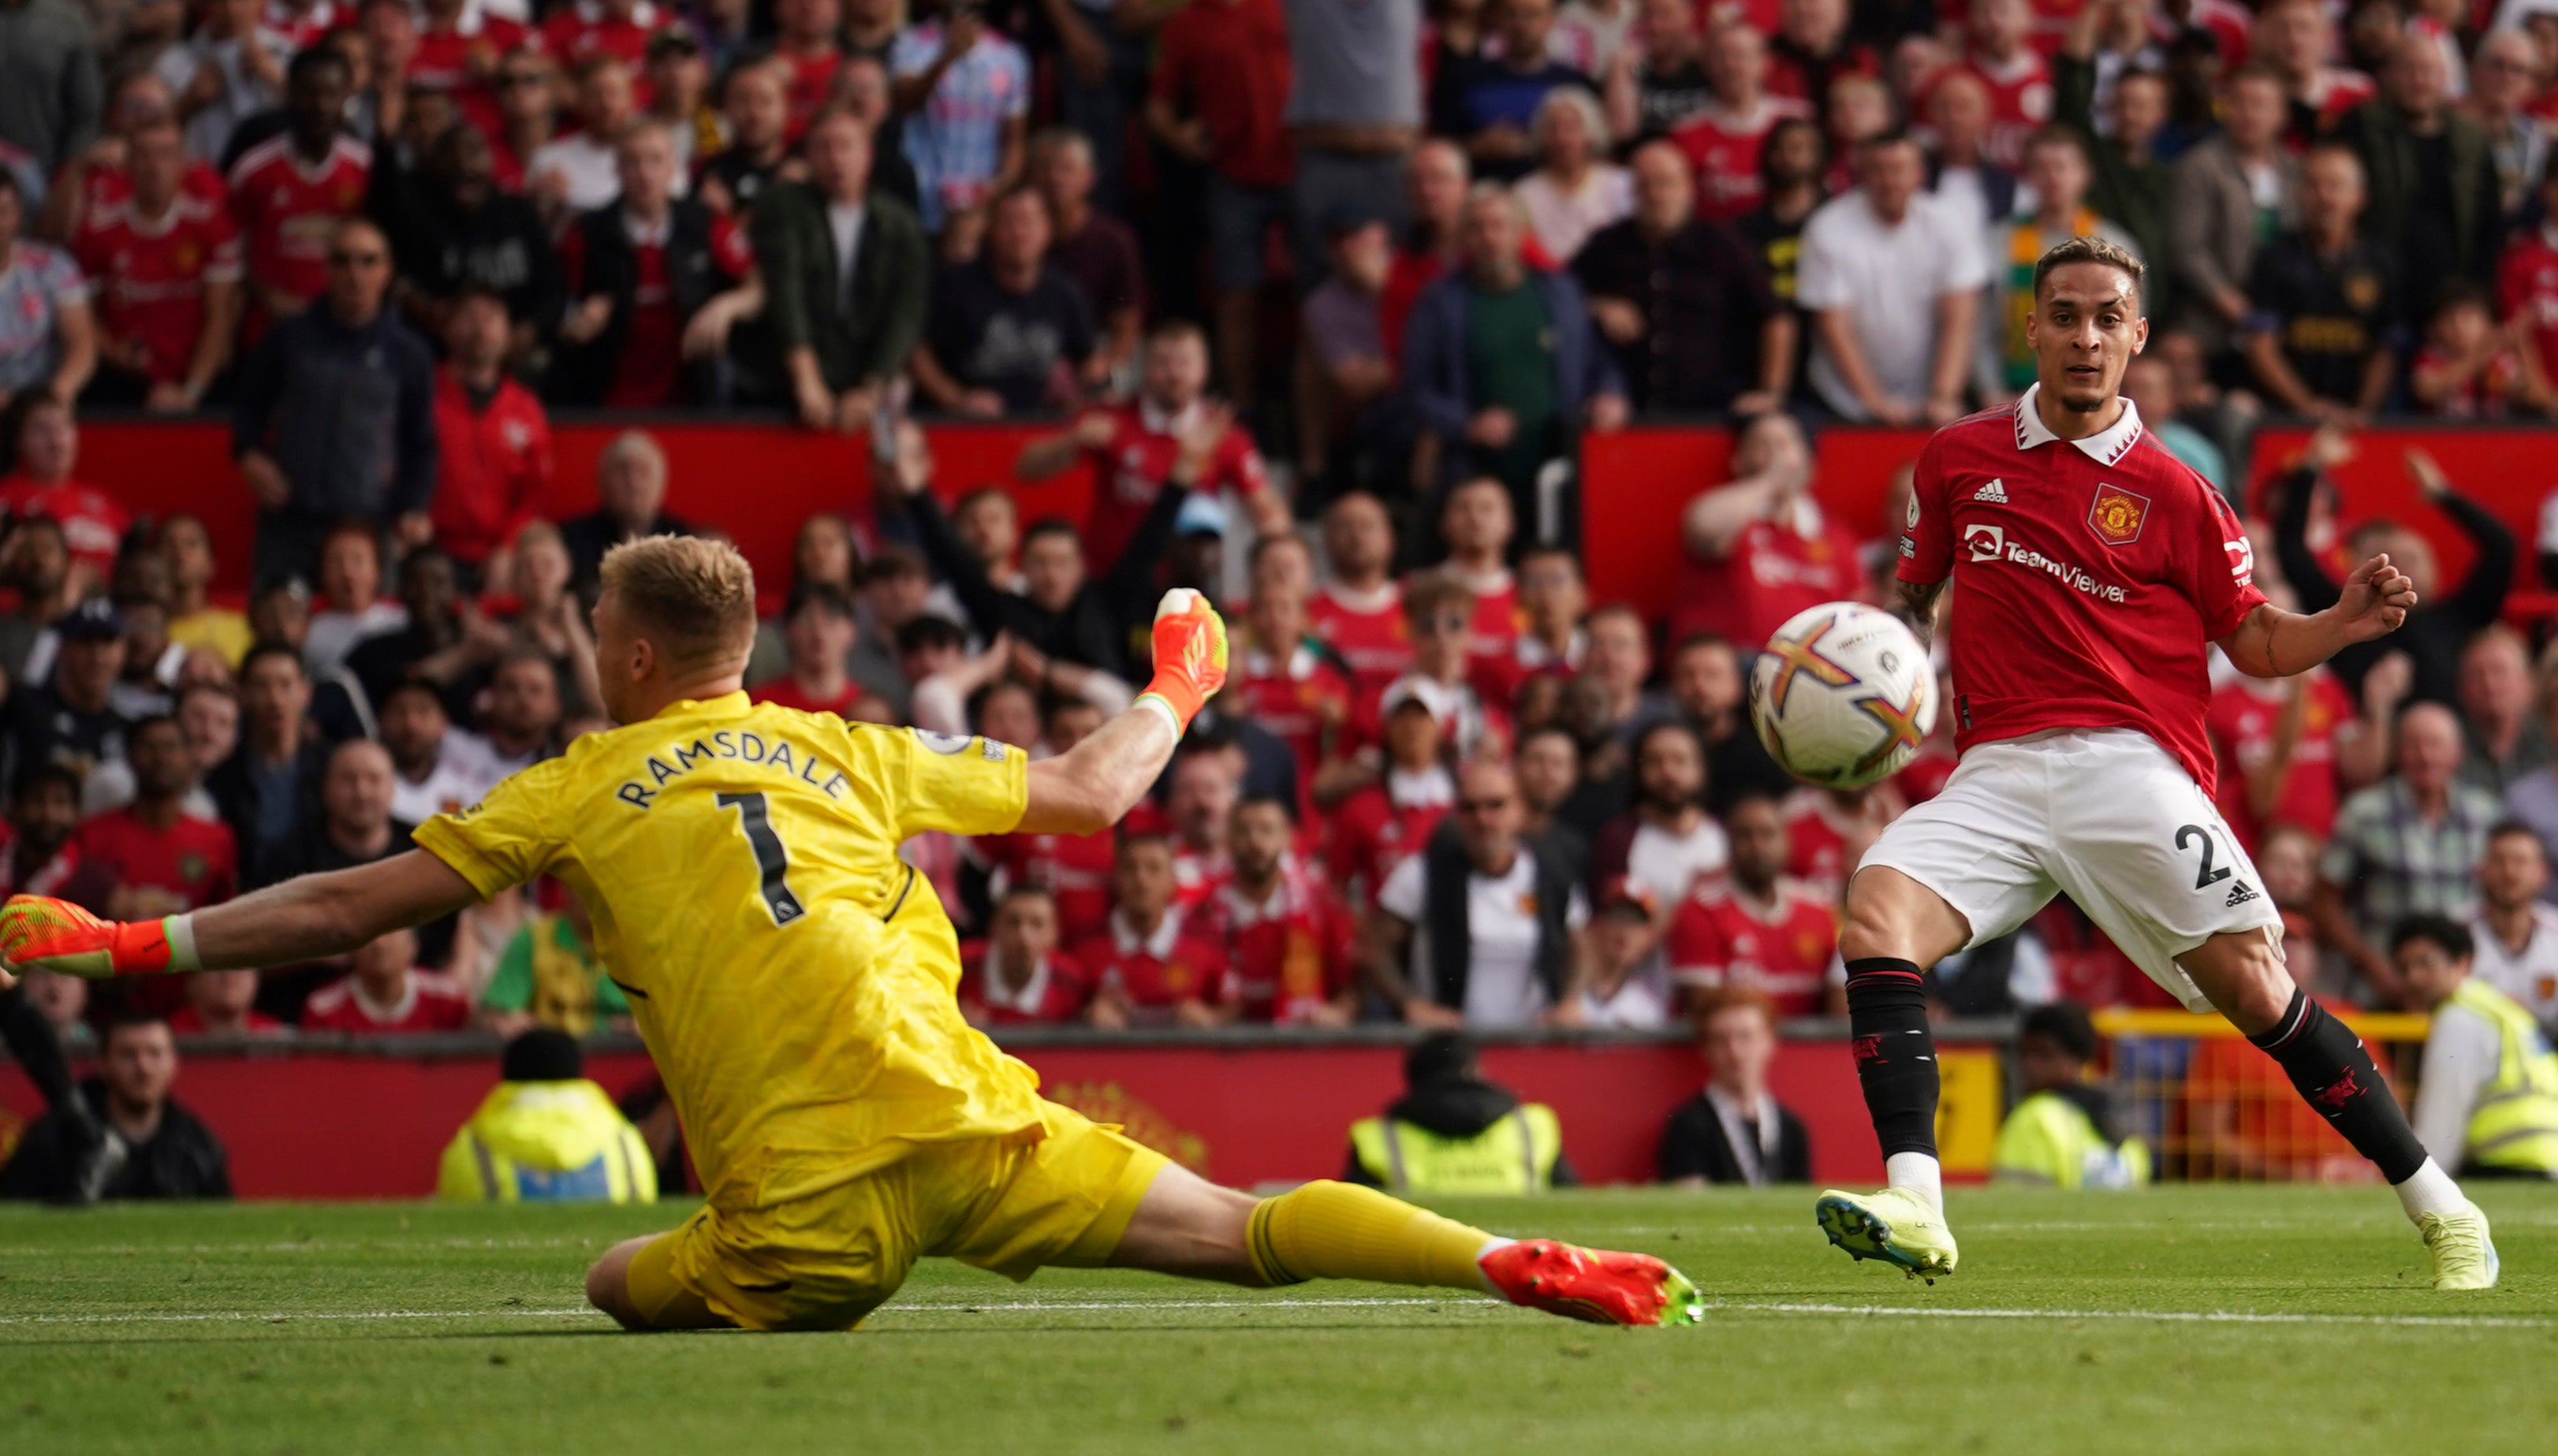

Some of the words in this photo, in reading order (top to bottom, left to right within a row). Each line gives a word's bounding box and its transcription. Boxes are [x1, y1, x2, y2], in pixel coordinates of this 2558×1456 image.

[1973, 492, 2009, 504] adidas
[2004, 541, 2131, 603] TeamViewer
[617, 731, 851, 810] RAMSDALE
[715, 791, 805, 926] 1
[2225, 892, 2261, 907] adidas
